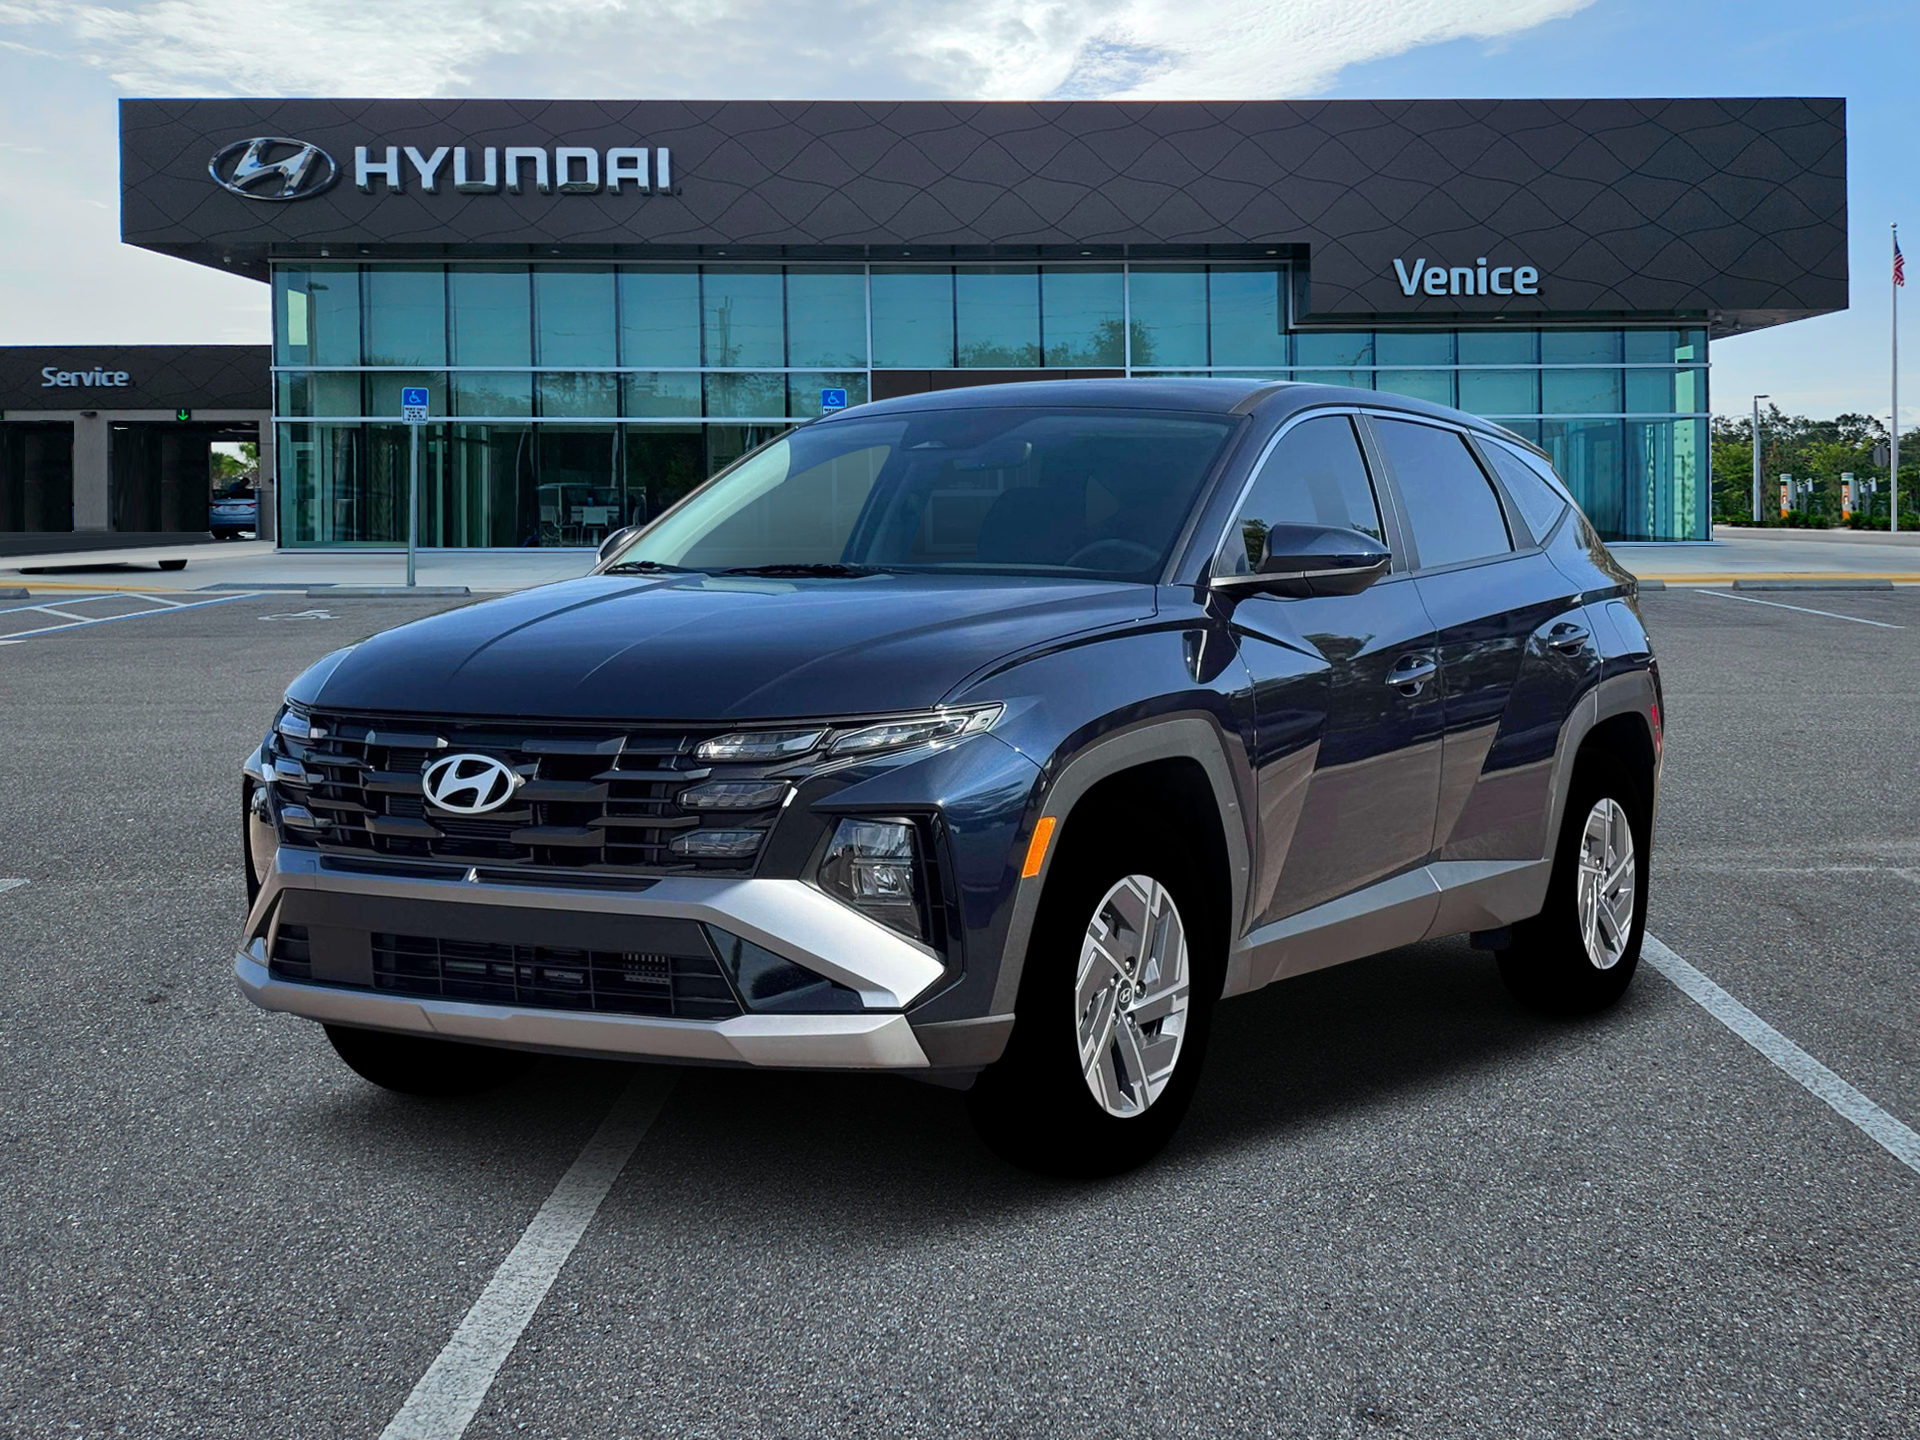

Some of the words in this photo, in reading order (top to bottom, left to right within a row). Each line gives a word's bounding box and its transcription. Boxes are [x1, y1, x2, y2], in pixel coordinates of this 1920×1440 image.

[355, 146, 672, 193] HYUNDAI
[1393, 257, 1539, 296] Venice
[41, 366, 130, 387] Service
